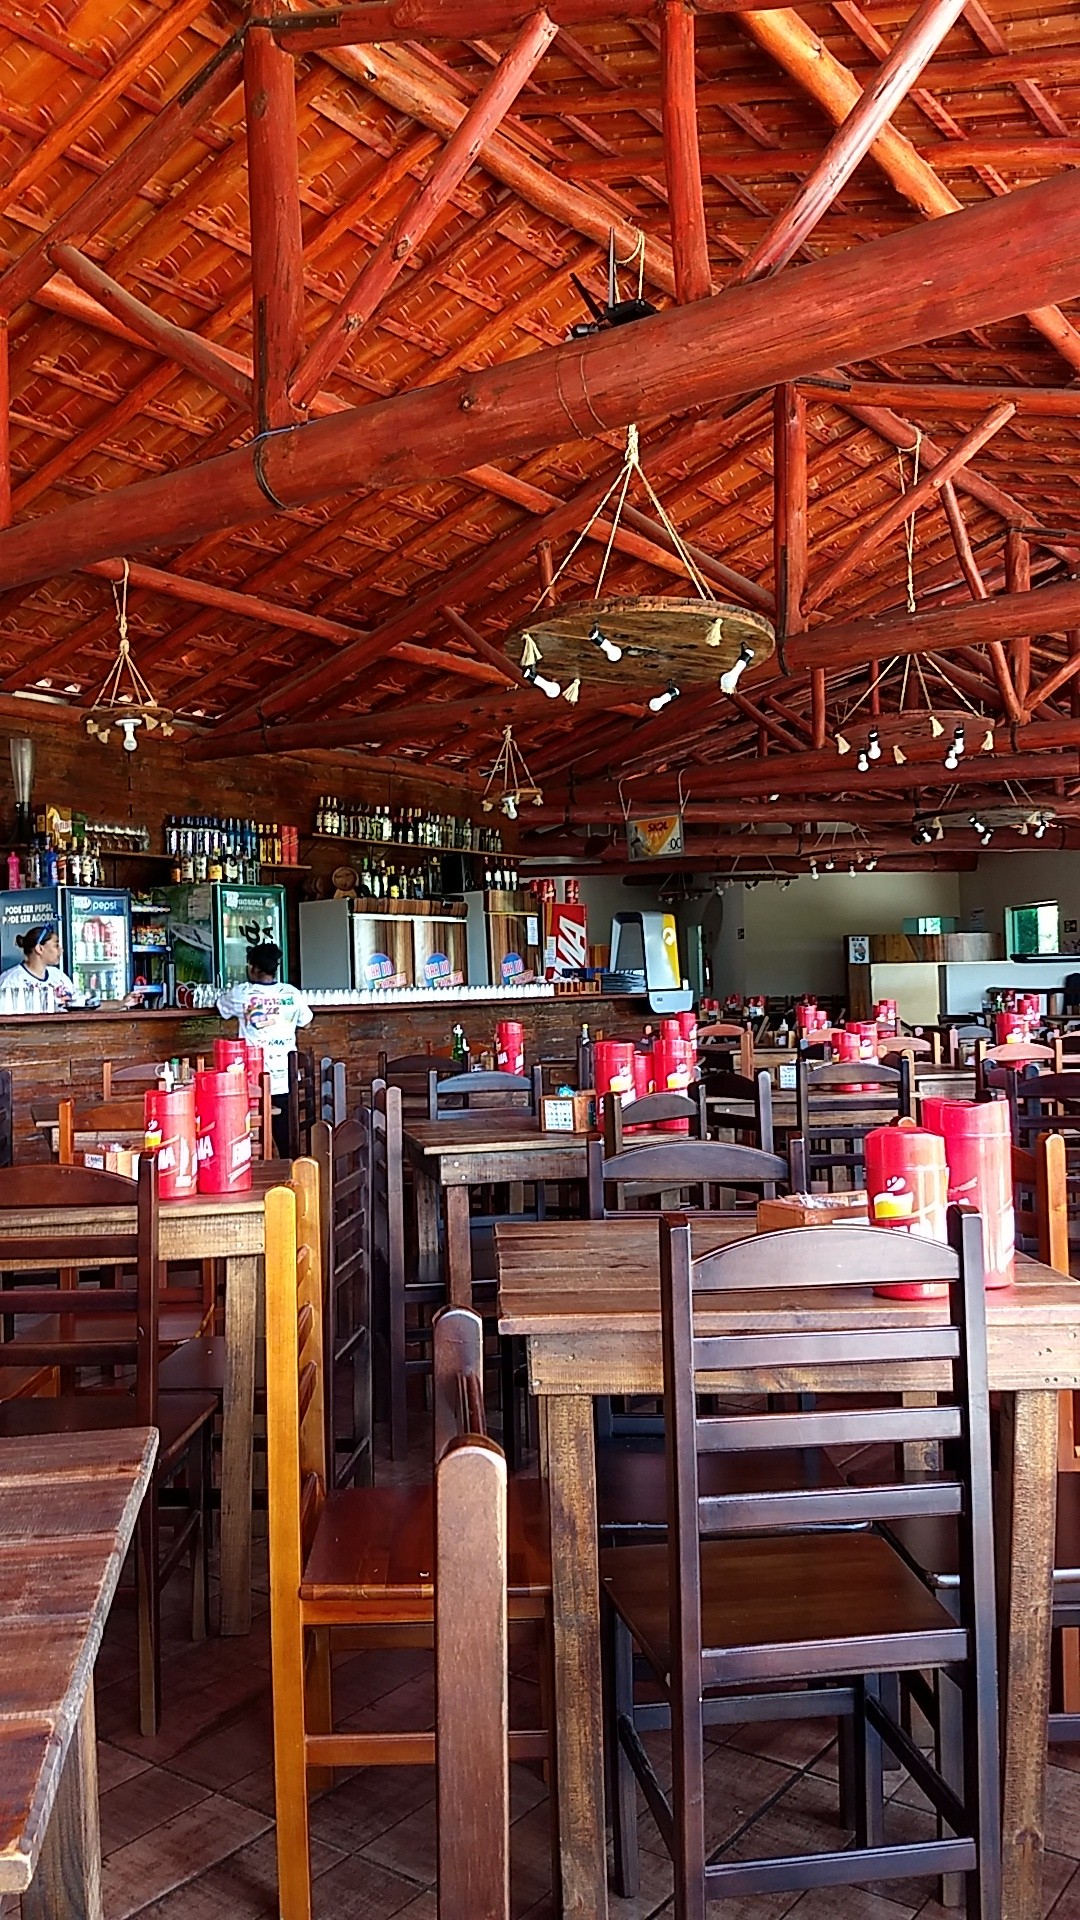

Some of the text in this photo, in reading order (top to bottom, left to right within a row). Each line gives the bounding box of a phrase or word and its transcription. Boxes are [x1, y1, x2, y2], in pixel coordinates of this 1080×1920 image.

[648, 821, 668, 832] SKOL
[5, 906, 22, 915] PODE
[23, 904, 34, 914] SER
[92, 901, 117, 911] pepsi
[20, 914, 31, 923] SER
